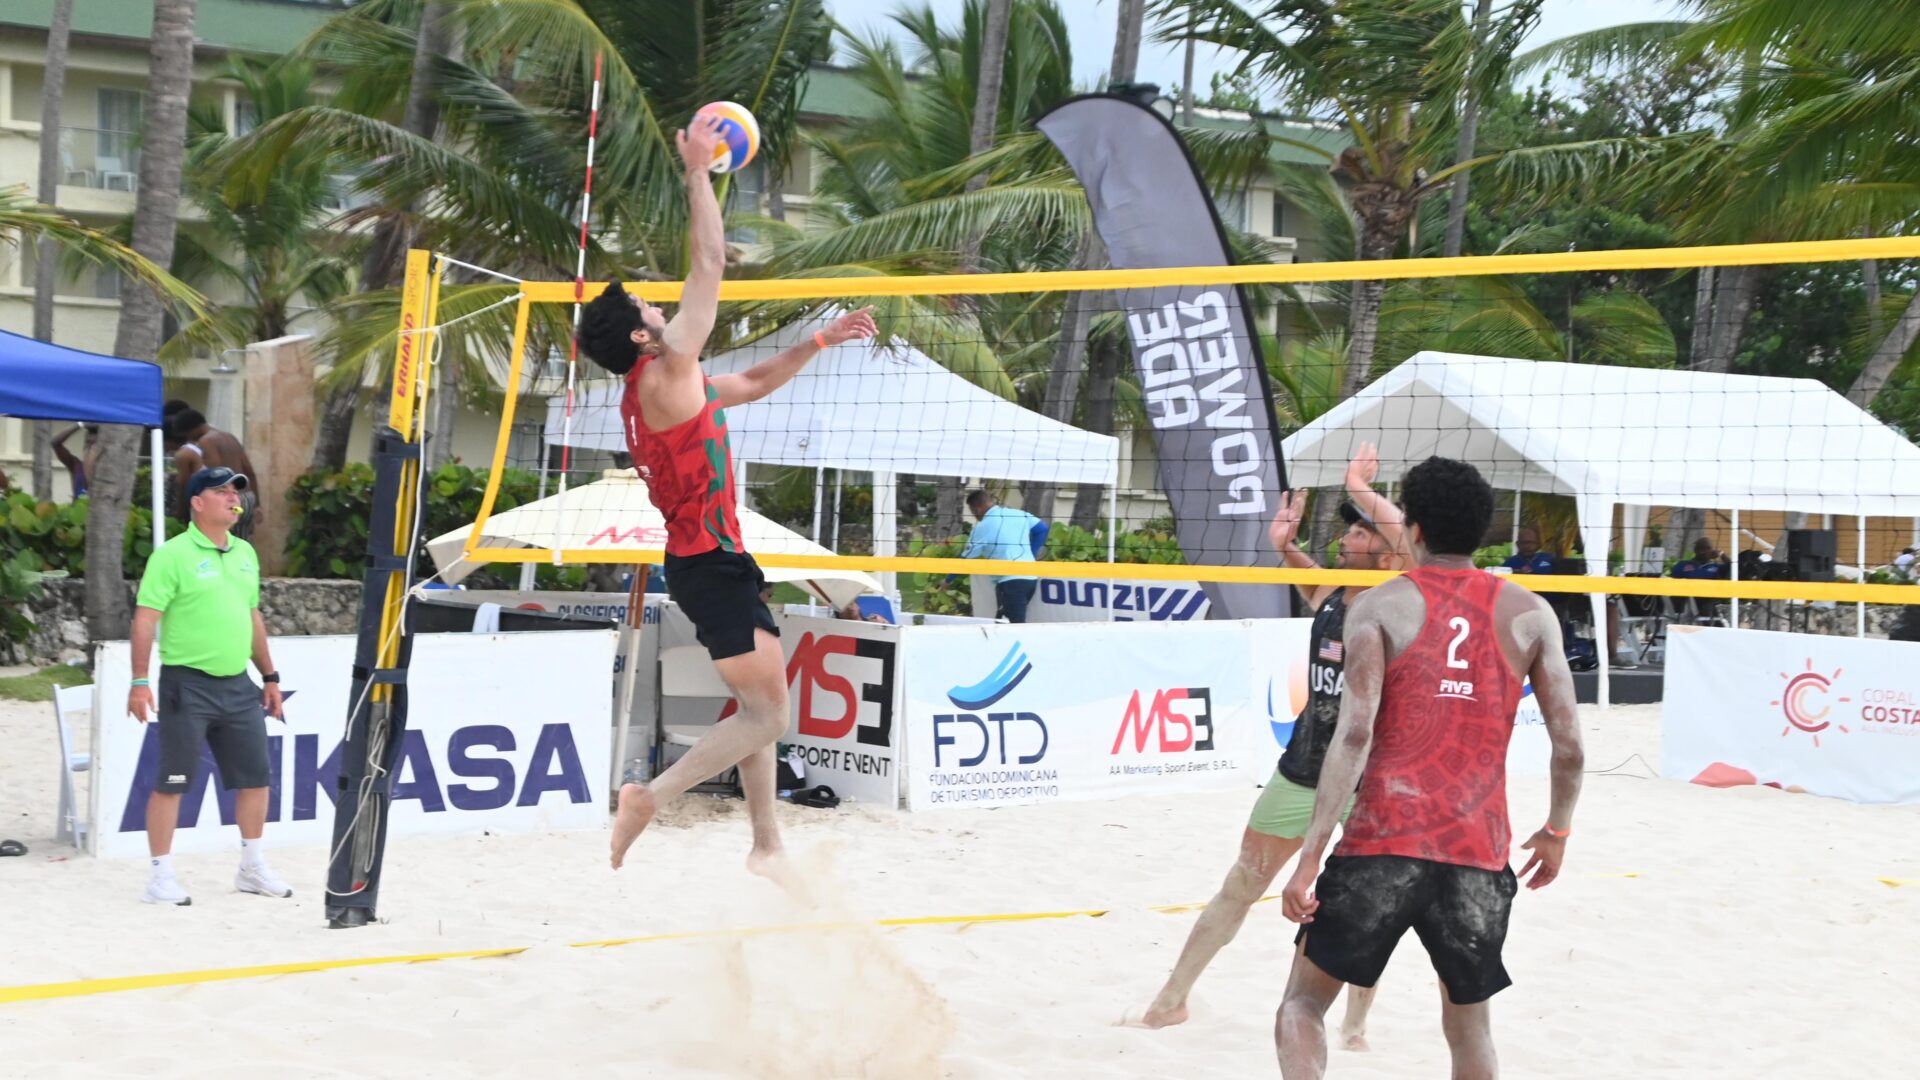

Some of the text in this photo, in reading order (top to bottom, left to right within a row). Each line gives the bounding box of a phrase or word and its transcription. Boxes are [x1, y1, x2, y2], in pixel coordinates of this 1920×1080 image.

[1446, 616, 1470, 670] 2
[1310, 663, 1345, 696] USA
[1862, 688, 1917, 706] CORAL
[1862, 705, 1920, 725] COSTA
[932, 711, 1049, 768] FDTD
[843, 751, 891, 778] EVENT
[1109, 765, 1121, 775] AA
[1123, 764, 1162, 776] Marketing
[1164, 763, 1187, 775] Sport
[992, 769, 1058, 784] DOMINICANA
[930, 785, 1058, 803] DE TURISMO DEPORTIVO
